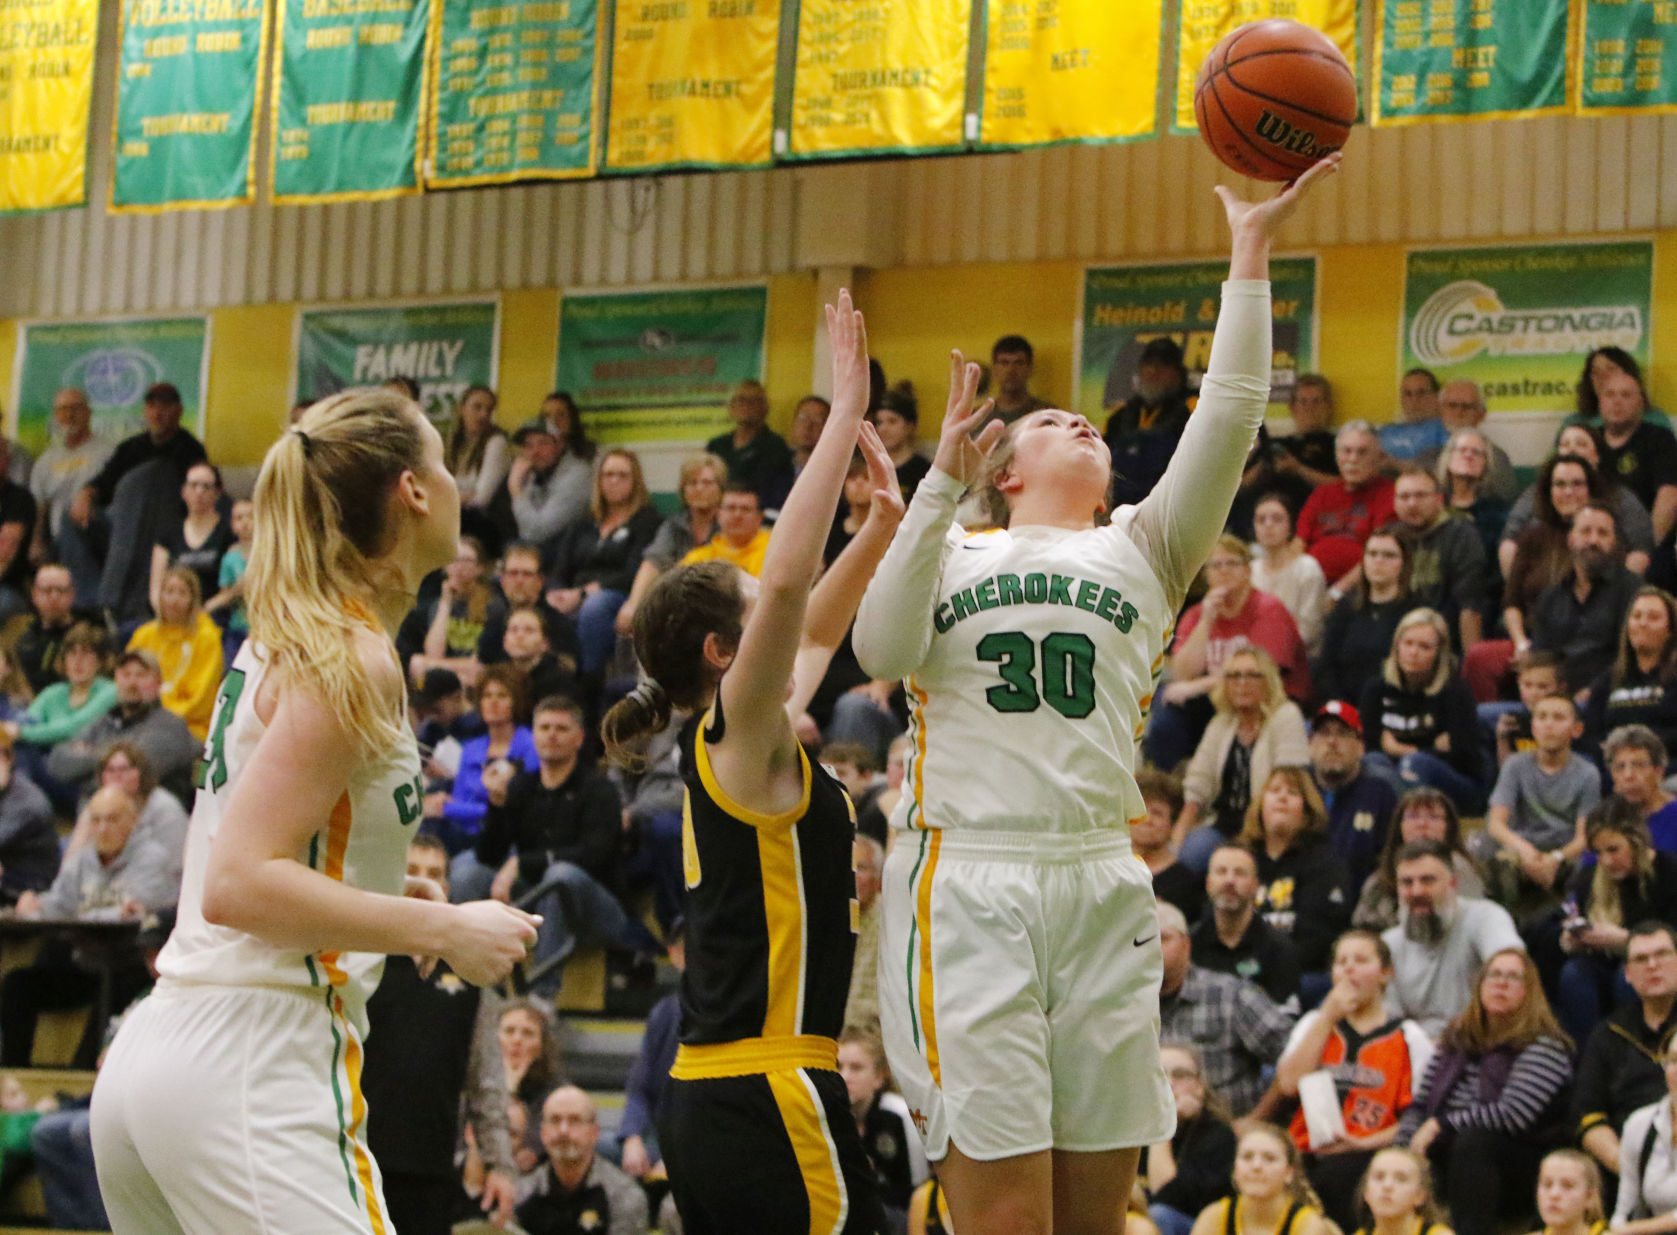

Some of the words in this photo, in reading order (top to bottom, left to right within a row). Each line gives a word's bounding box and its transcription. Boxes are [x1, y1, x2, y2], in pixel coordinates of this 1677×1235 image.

[648, 79, 743, 100] TOURNAMENT
[831, 69, 932, 92] TOURNAMENT
[306, 101, 396, 125] TOURNAMENT
[467, 88, 564, 117] TOURNAMENT
[142, 112, 231, 137] TOURNAMENT
[1093, 299, 1186, 328] Heinold
[1196, 299, 1214, 322] &
[1446, 309, 1638, 337] CASTONGIA
[352, 339, 465, 382] FAMILY
[933, 572, 1140, 635] CHEROKEES
[975, 630, 1096, 719] 30
